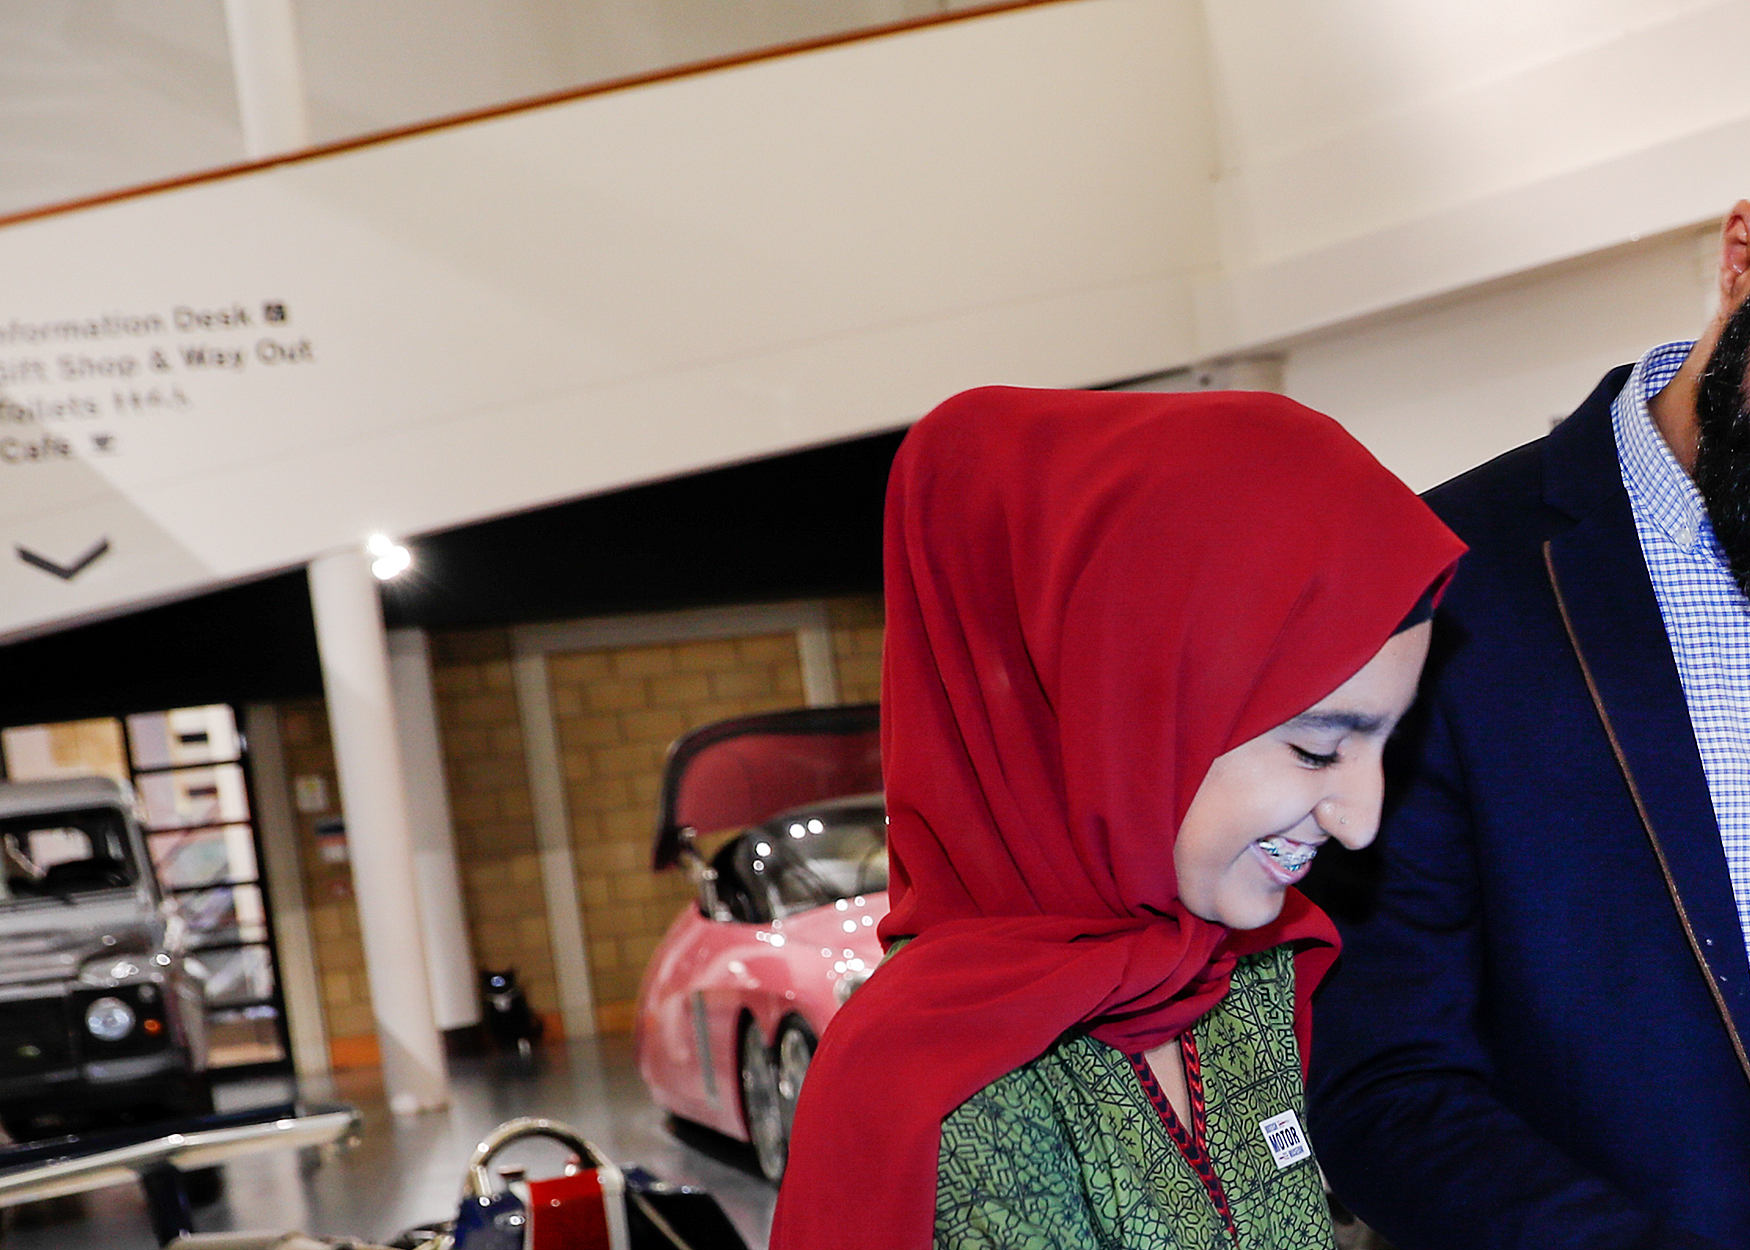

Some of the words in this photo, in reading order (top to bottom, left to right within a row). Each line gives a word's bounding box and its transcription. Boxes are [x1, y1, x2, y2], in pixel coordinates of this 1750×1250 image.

[172, 303, 251, 332] Desk
[57, 352, 138, 382] Shop
[150, 346, 171, 372] &
[178, 345, 243, 374] Way
[256, 336, 314, 365] Out
[1268, 1126, 1300, 1153] MOTOR
